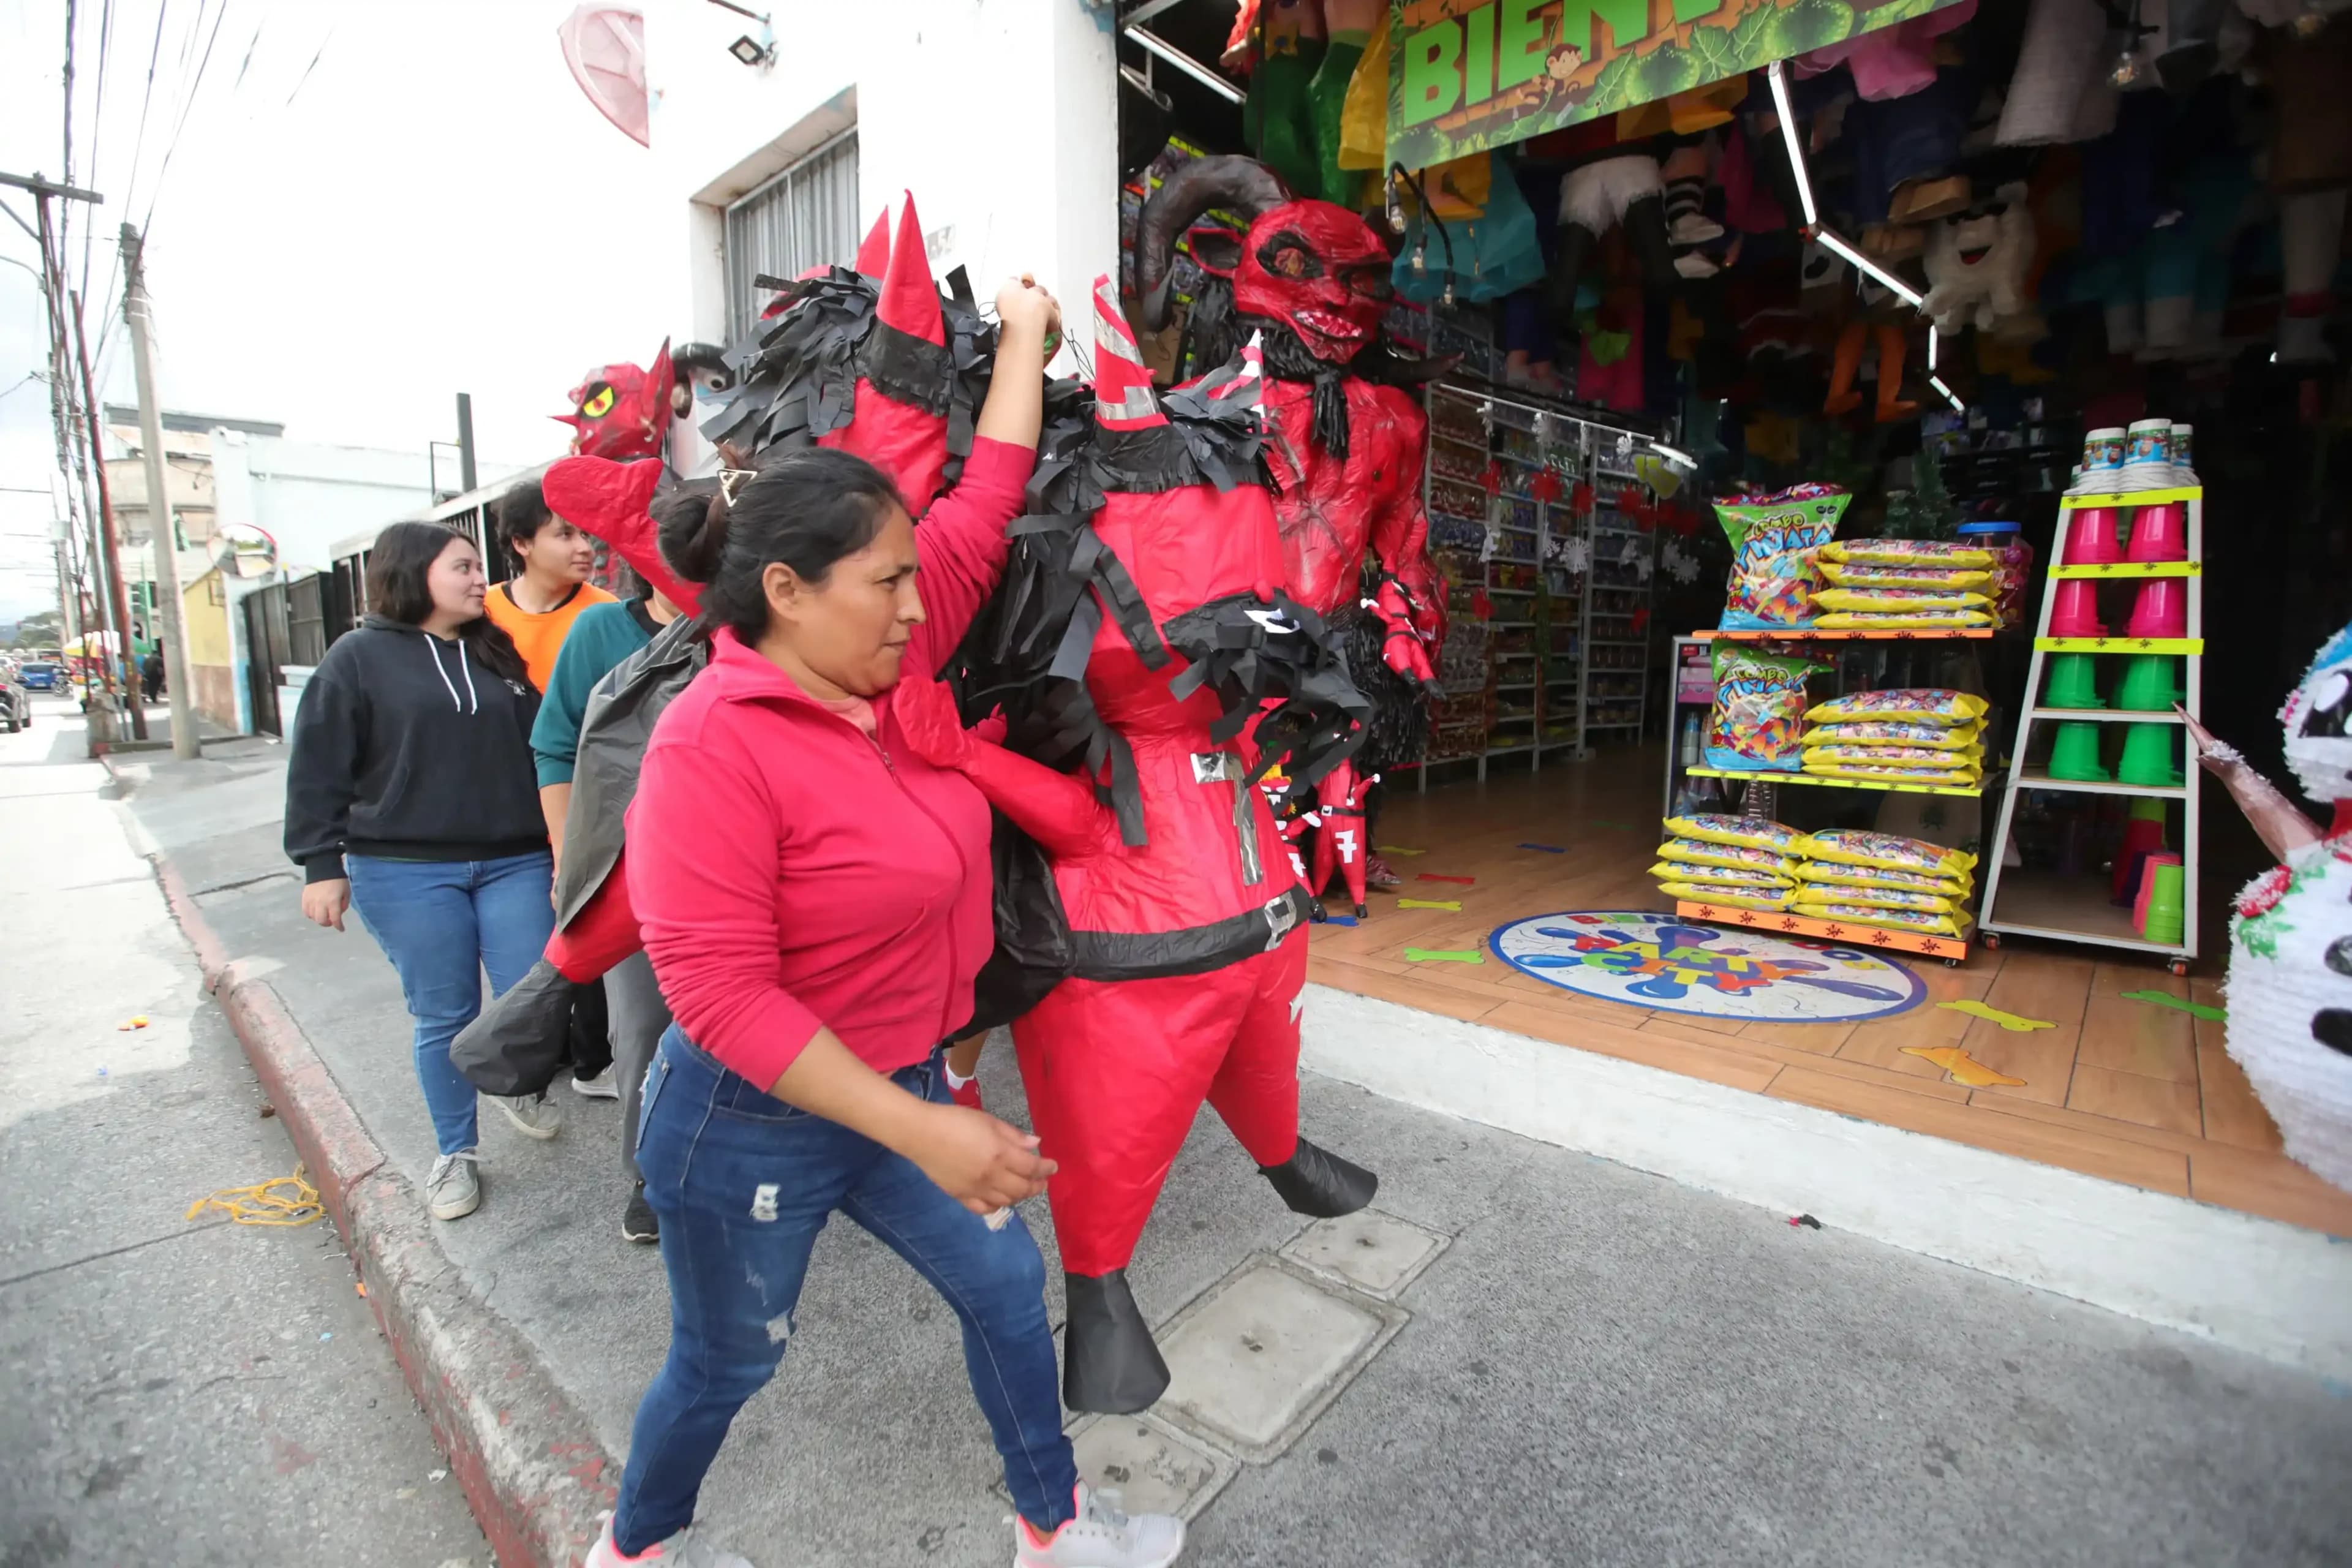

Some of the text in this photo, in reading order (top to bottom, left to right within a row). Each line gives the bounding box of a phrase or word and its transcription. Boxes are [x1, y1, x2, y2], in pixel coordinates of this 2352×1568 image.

[1404, 0, 1722, 127] BIEN
[1575, 935, 1809, 980] PARTY
[1581, 952, 1773, 991] CITY
